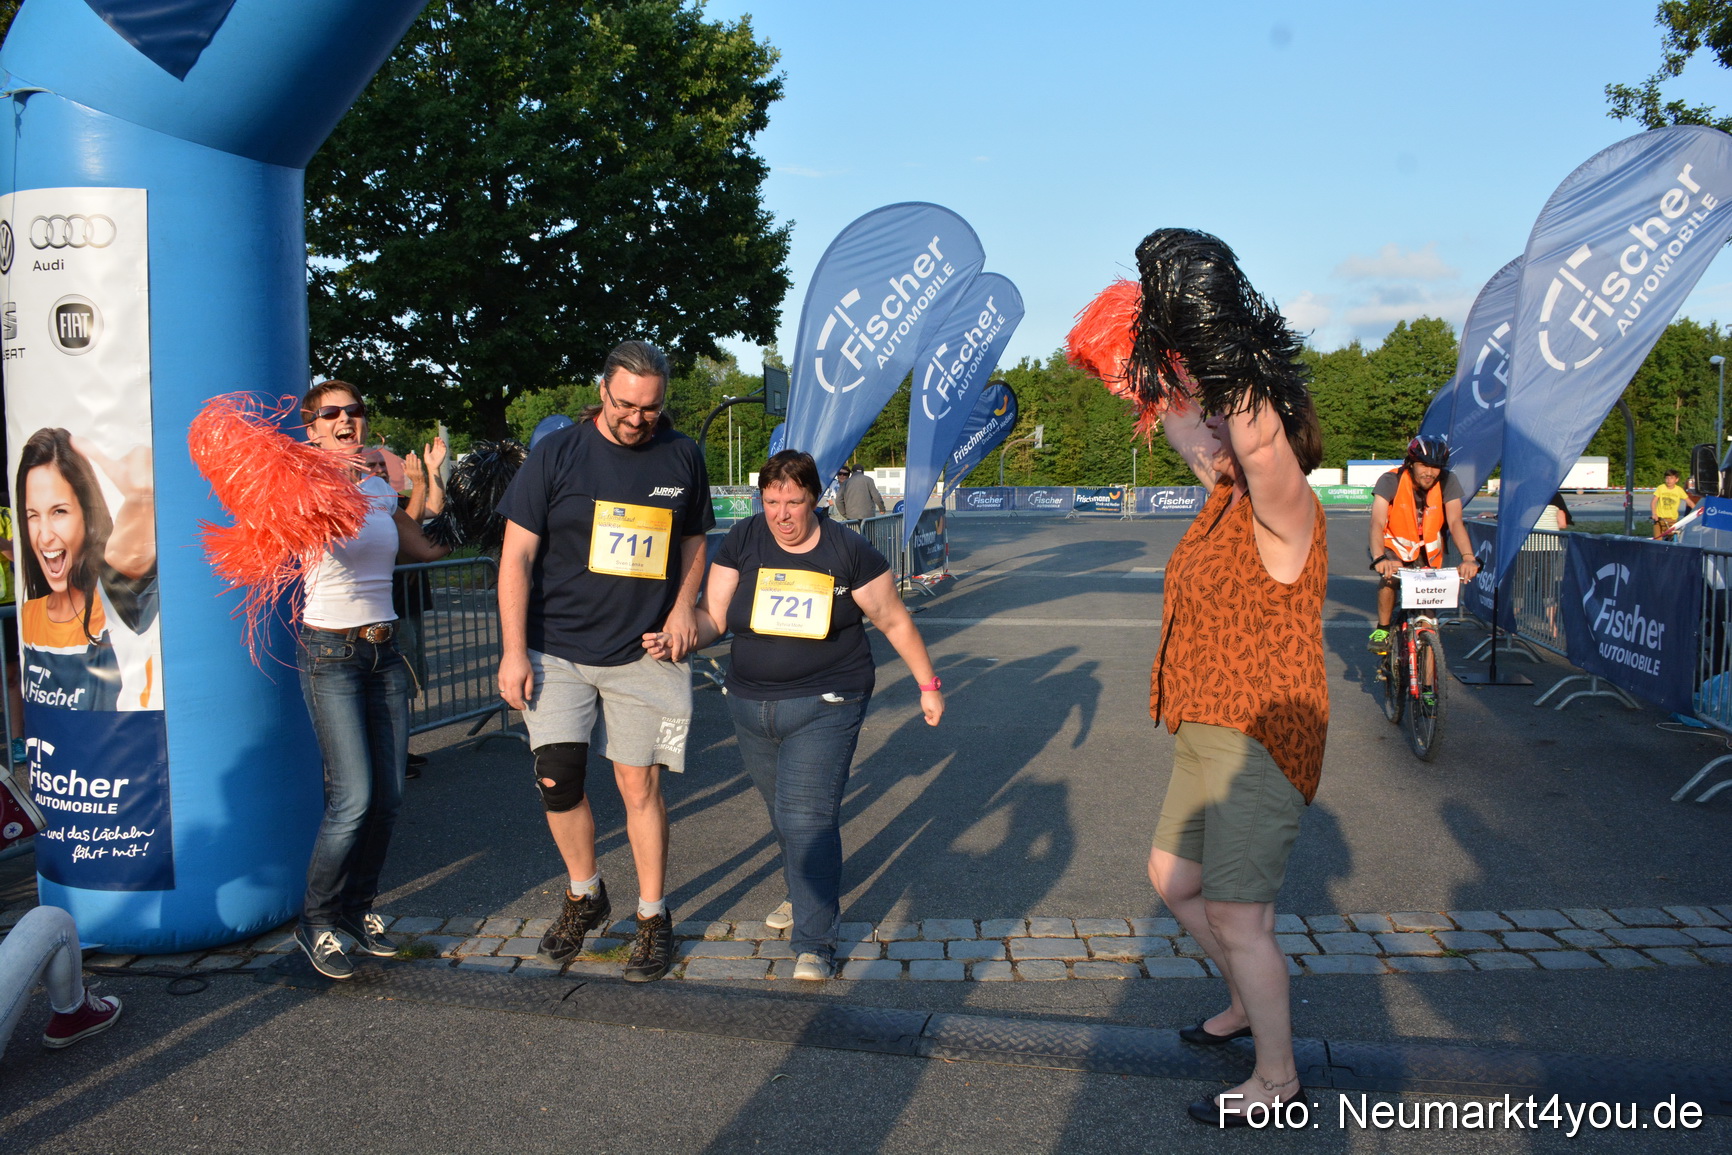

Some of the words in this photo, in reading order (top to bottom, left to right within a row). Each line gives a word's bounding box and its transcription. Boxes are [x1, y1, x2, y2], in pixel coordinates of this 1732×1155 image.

[32, 259, 65, 272] Audi
[1569, 163, 1702, 342] Fischer
[1615, 192, 1719, 338] AUTOMOBILE
[840, 235, 947, 371] Fischer
[876, 262, 956, 370] AUTOMOBILE
[59, 312, 91, 339] FIAT
[936, 295, 1000, 403] Fischer
[957, 313, 1006, 401] AUTOMOBILE
[953, 417, 999, 465] Frischmann
[974, 496, 1004, 504] Fischer
[1034, 496, 1064, 504] Fischer
[1076, 494, 1111, 504] Frischmann
[1159, 497, 1196, 506] Fischer
[609, 531, 653, 558] 711
[770, 595, 813, 619] 721
[1593, 597, 1665, 651] Fischer
[29, 681, 86, 708] Fischer
[655, 721, 689, 749] 52
[30, 760, 130, 799] Fischer
[35, 792, 119, 815] AUTOMOBILE
[67, 825, 90, 841] das
[91, 825, 155, 842] Lächeln
[72, 843, 109, 864] fährt
[112, 842, 151, 857] mit!
